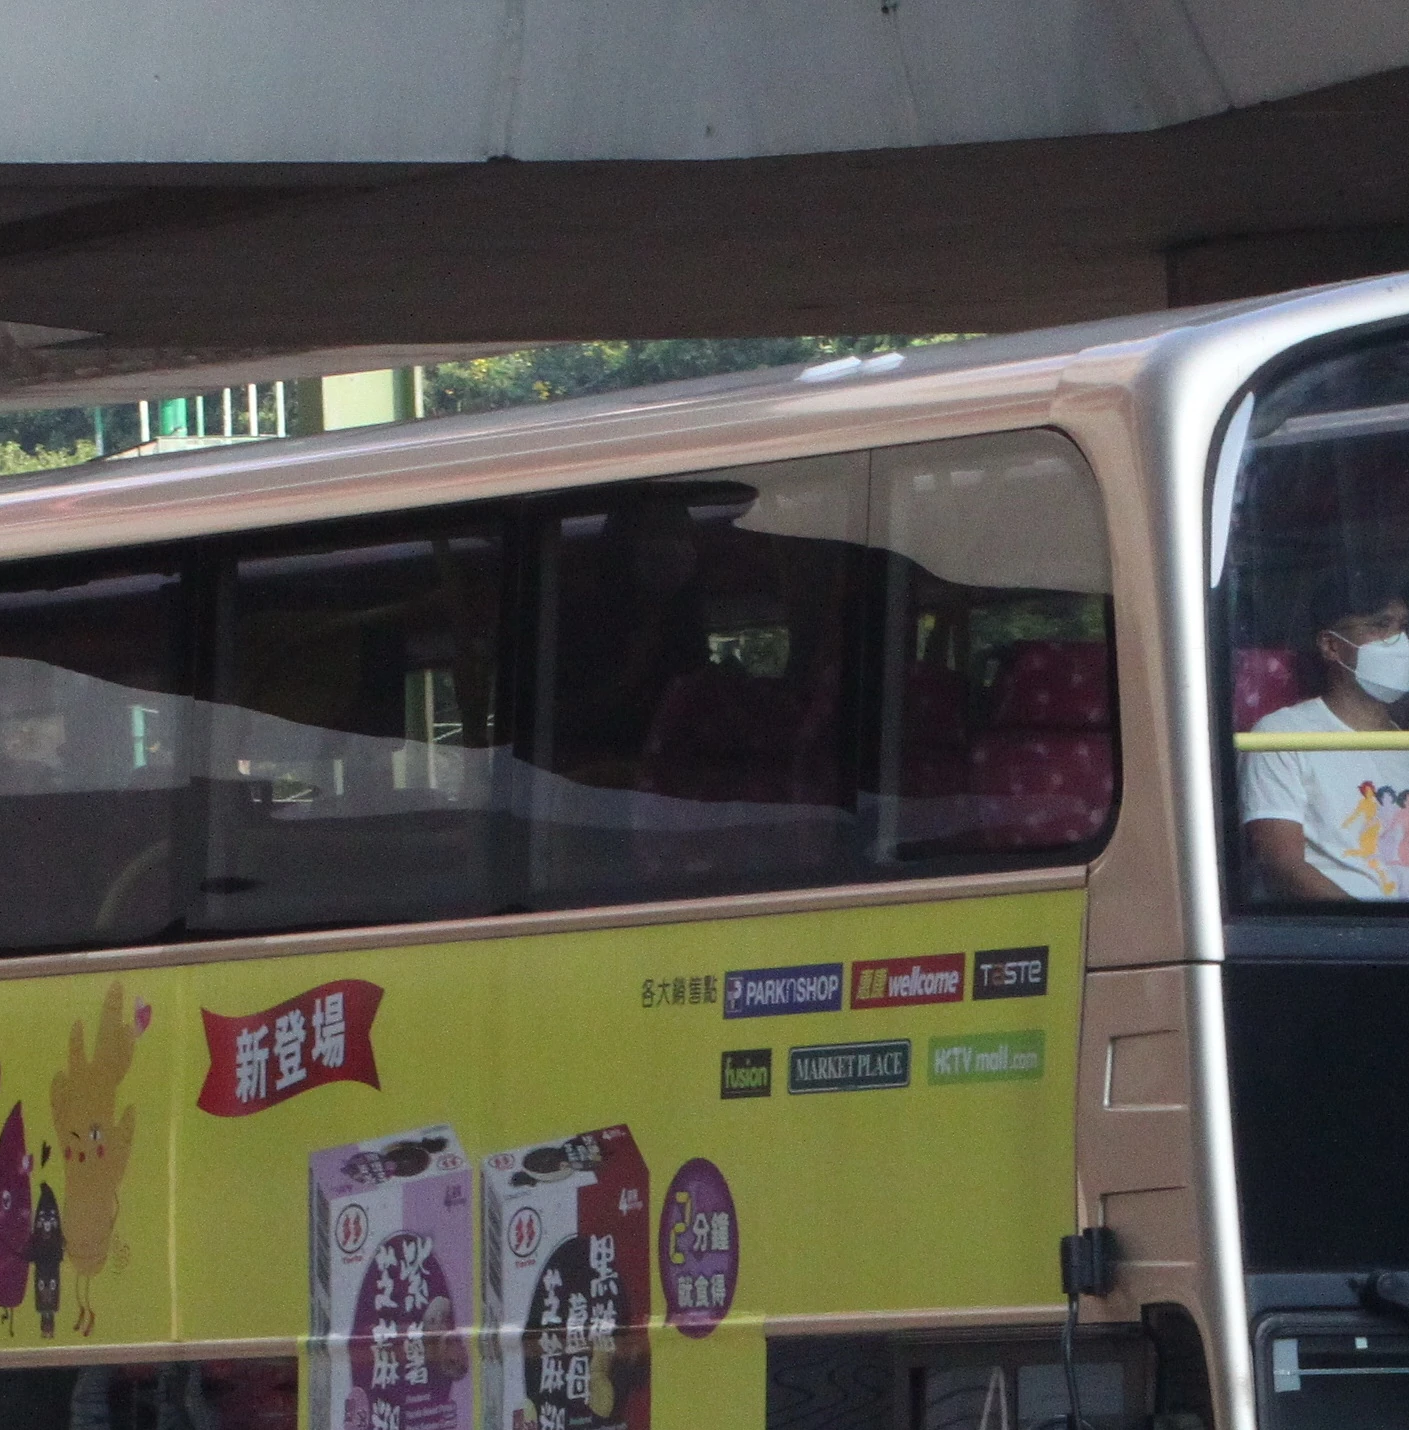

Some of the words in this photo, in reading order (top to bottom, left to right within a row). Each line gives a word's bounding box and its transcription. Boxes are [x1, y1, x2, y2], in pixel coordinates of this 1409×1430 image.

[641, 974, 718, 1009] 各大銷售點
[888, 965, 960, 998] wellcome
[235, 991, 347, 1104] 新登場
[723, 1055, 768, 1089] fusion
[795, 1056, 855, 1082] MARKET
[857, 1050, 904, 1078] PLACE
